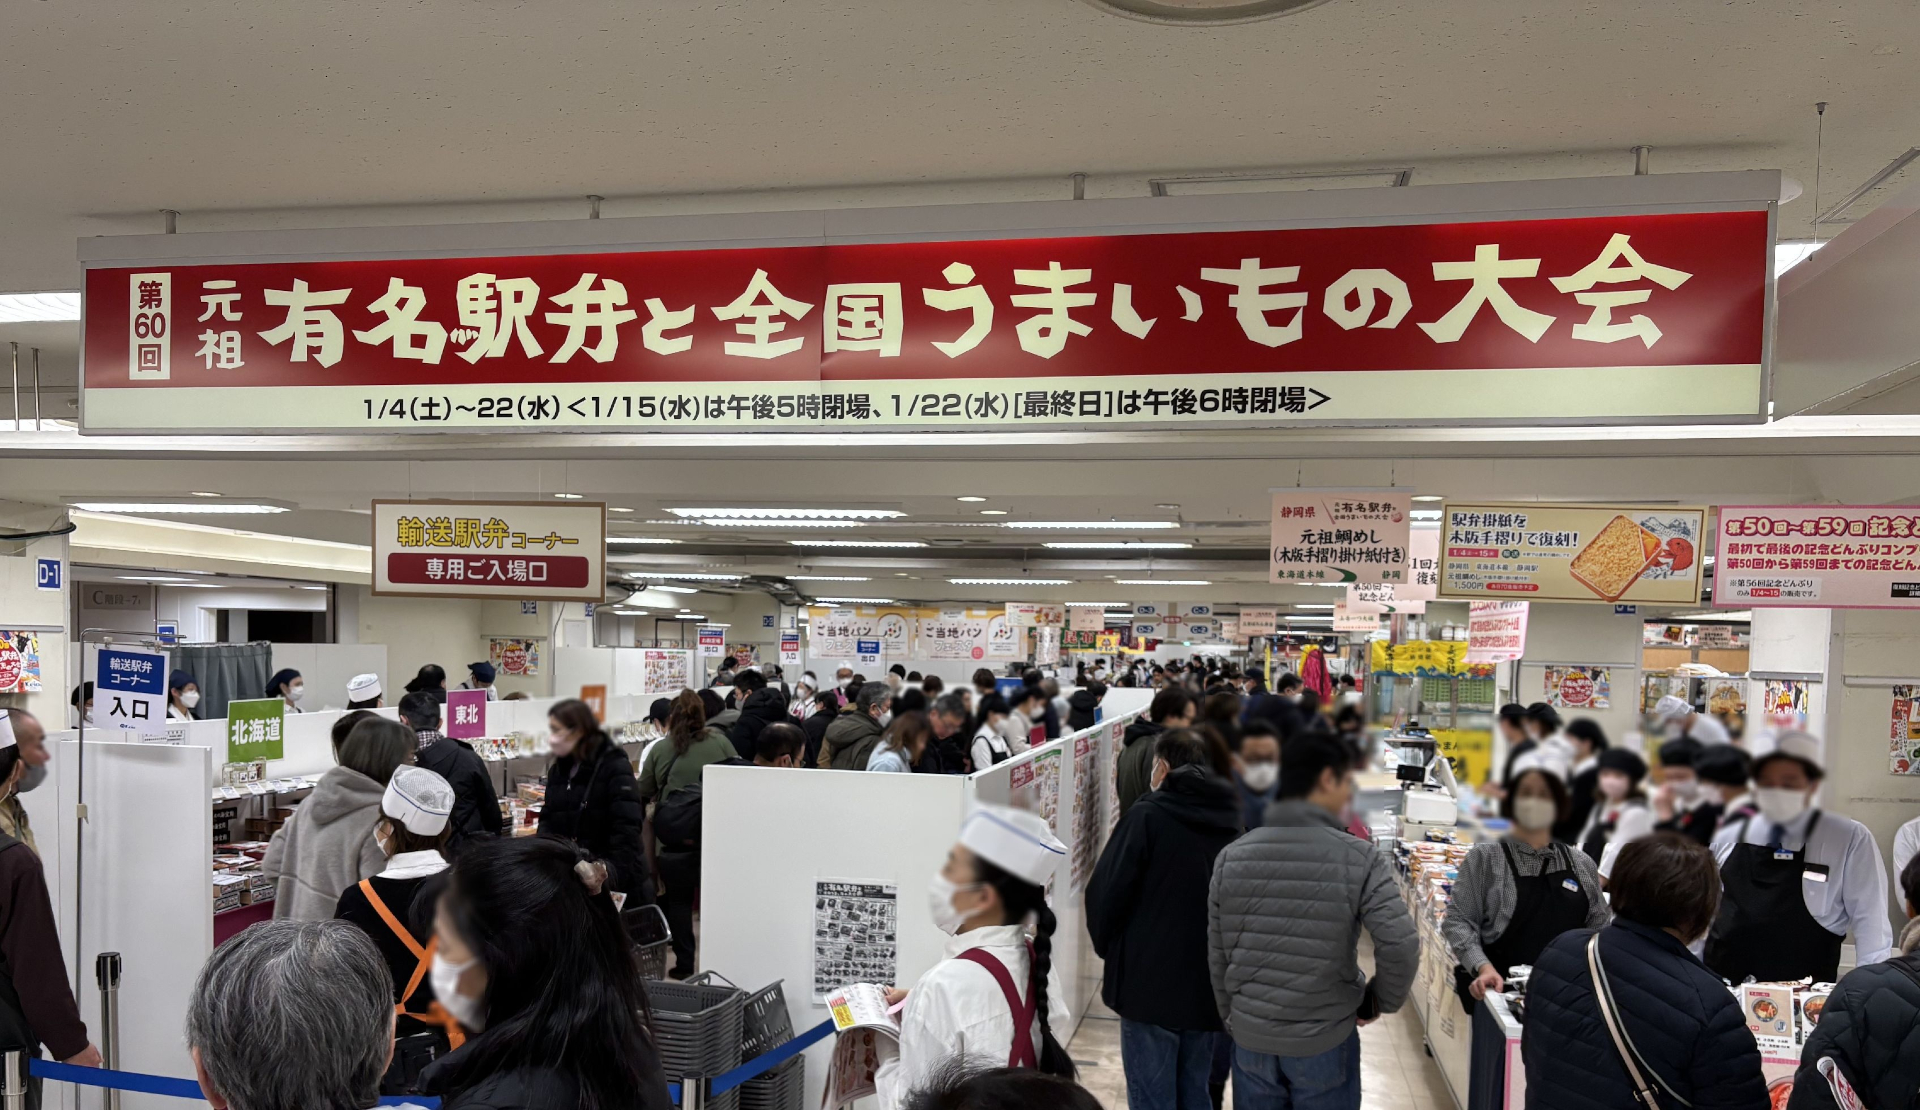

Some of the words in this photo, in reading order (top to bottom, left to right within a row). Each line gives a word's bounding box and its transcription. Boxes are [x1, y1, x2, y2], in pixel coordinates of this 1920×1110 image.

[256, 232, 1693, 370] 有名駅弁と全国うまいもの大会
[134, 280, 168, 374] 第60回
[195, 280, 245, 370] 元祖
[1280, 506, 1316, 518] 静岡県
[1451, 513, 1527, 528] 駅弁掛紙を
[397, 516, 579, 551] 輸送駅弁コーナー
[1299, 529, 1383, 545] 元祖鯛めし
[1449, 530, 1578, 547] 木版手摺りで復刻!
[1273, 546, 1406, 564] (木版手摺り掛け紙付き)
[1727, 542, 1920, 555] 最初で最後の記念どんぶりコンプ
[425, 558, 548, 582] 専用ご入場口
[1448, 562, 1470, 570] 静岡県
[1476, 563, 1509, 571] 東海道本線
[1516, 564, 1539, 572] 静岡駅
[1726, 558, 1920, 571] 第50回から第59回までの記念どん
[38, 562, 60, 586] D-1
[1277, 570, 1325, 580] 東海道本線
[1381, 570, 1401, 580] 静岡
[1453, 581, 1484, 590] 1,500円
[817, 625, 872, 637] ご当地パン
[926, 626, 982, 639] ご当地パン
[1063, 629, 1095, 644] 昆布
[109, 657, 153, 674] 輸送駅弁
[110, 673, 151, 686] コーナー
[109, 696, 150, 720] 入口
[455, 704, 479, 725] 東北
[231, 716, 282, 746] 北海道
